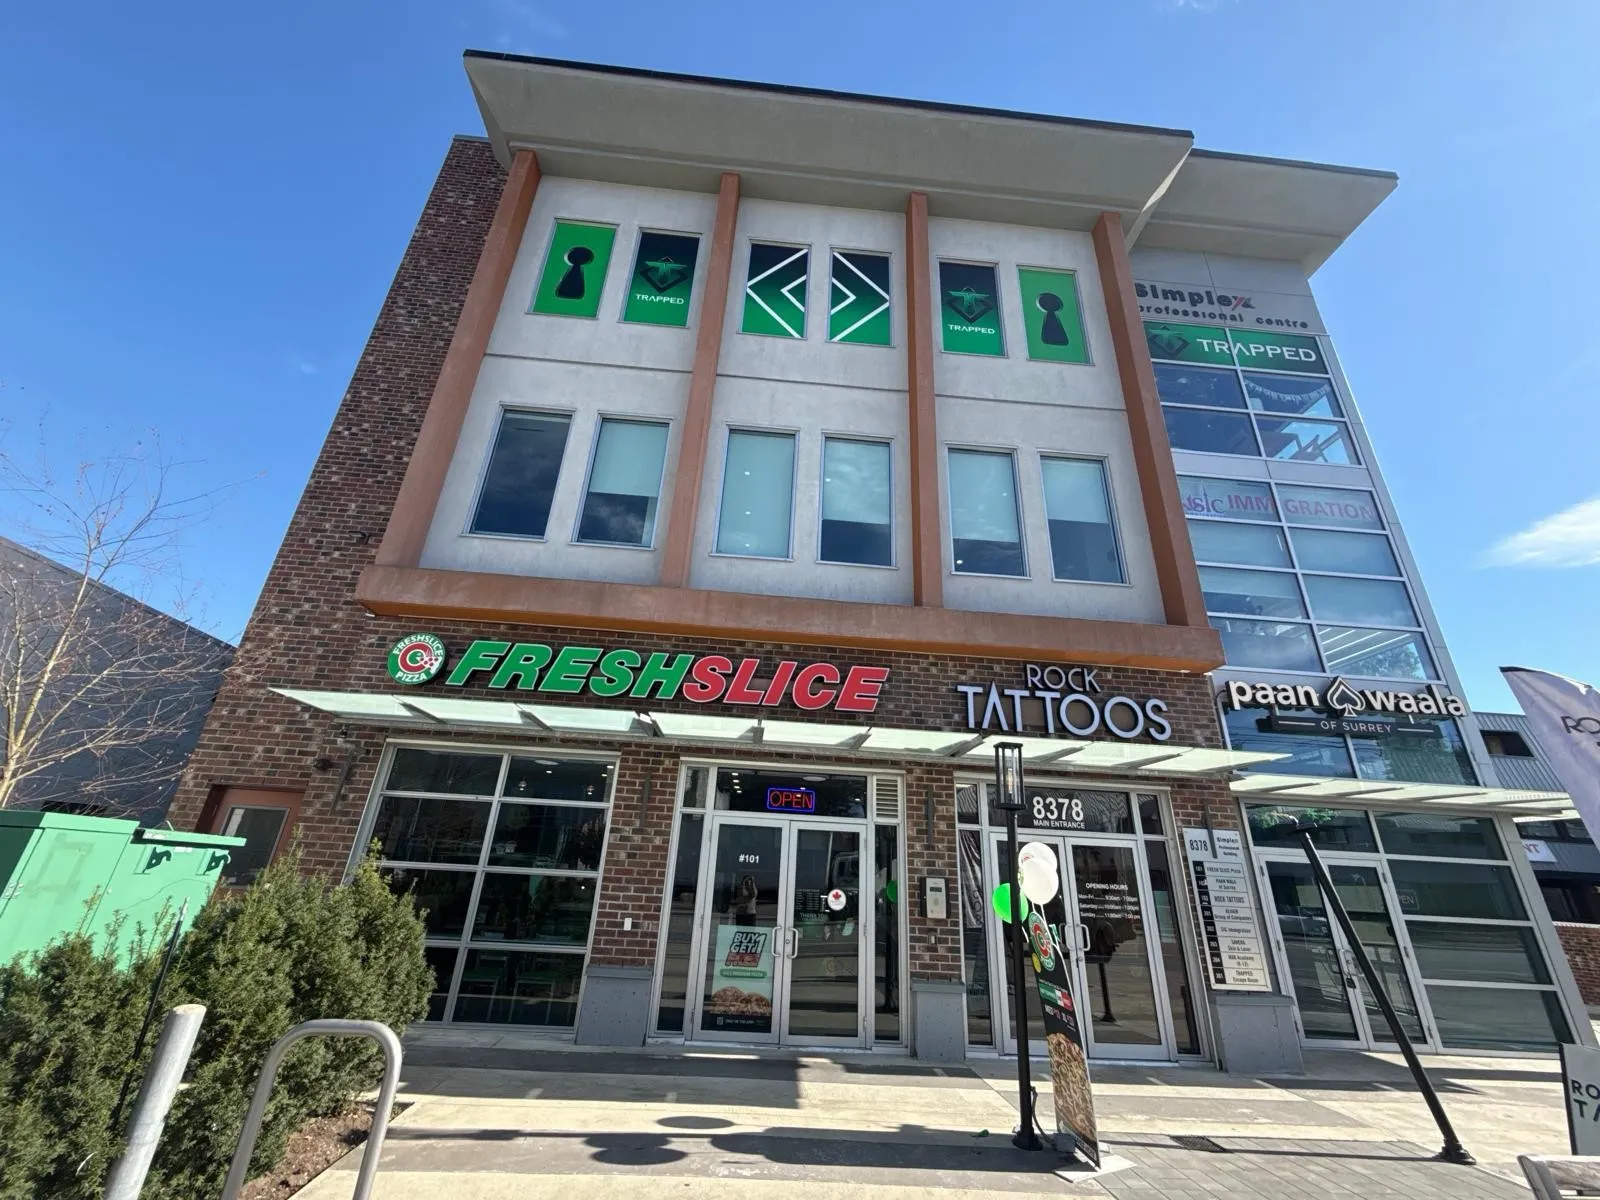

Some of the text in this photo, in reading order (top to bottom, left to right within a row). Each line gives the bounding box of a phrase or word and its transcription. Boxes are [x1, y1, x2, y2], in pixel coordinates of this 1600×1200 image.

[635, 293, 685, 305] TRAPPED
[1255, 316, 1309, 329] centre
[947, 324, 995, 335] TRAPPED
[1196, 338, 1317, 363] TRAPPED
[392, 634, 444, 656] FRESHSLICE
[395, 671, 428, 682] PIZZA
[445, 639, 890, 712] FRESHSLICE
[1026, 664, 1101, 693] ROCK
[1227, 679, 1467, 716] paan waala
[956, 680, 1172, 742] TATTOOS
[1320, 720, 1392, 734] OF SURREY
[769, 790, 813, 809] OPEN
[1032, 796, 1084, 822] 8378
[1033, 819, 1086, 830] MAIN ENTRANCE
[1189, 839, 1209, 852] 8378
[738, 854, 760, 864] #101
[734, 932, 758, 943] BUY
[731, 942, 753, 953] GET
